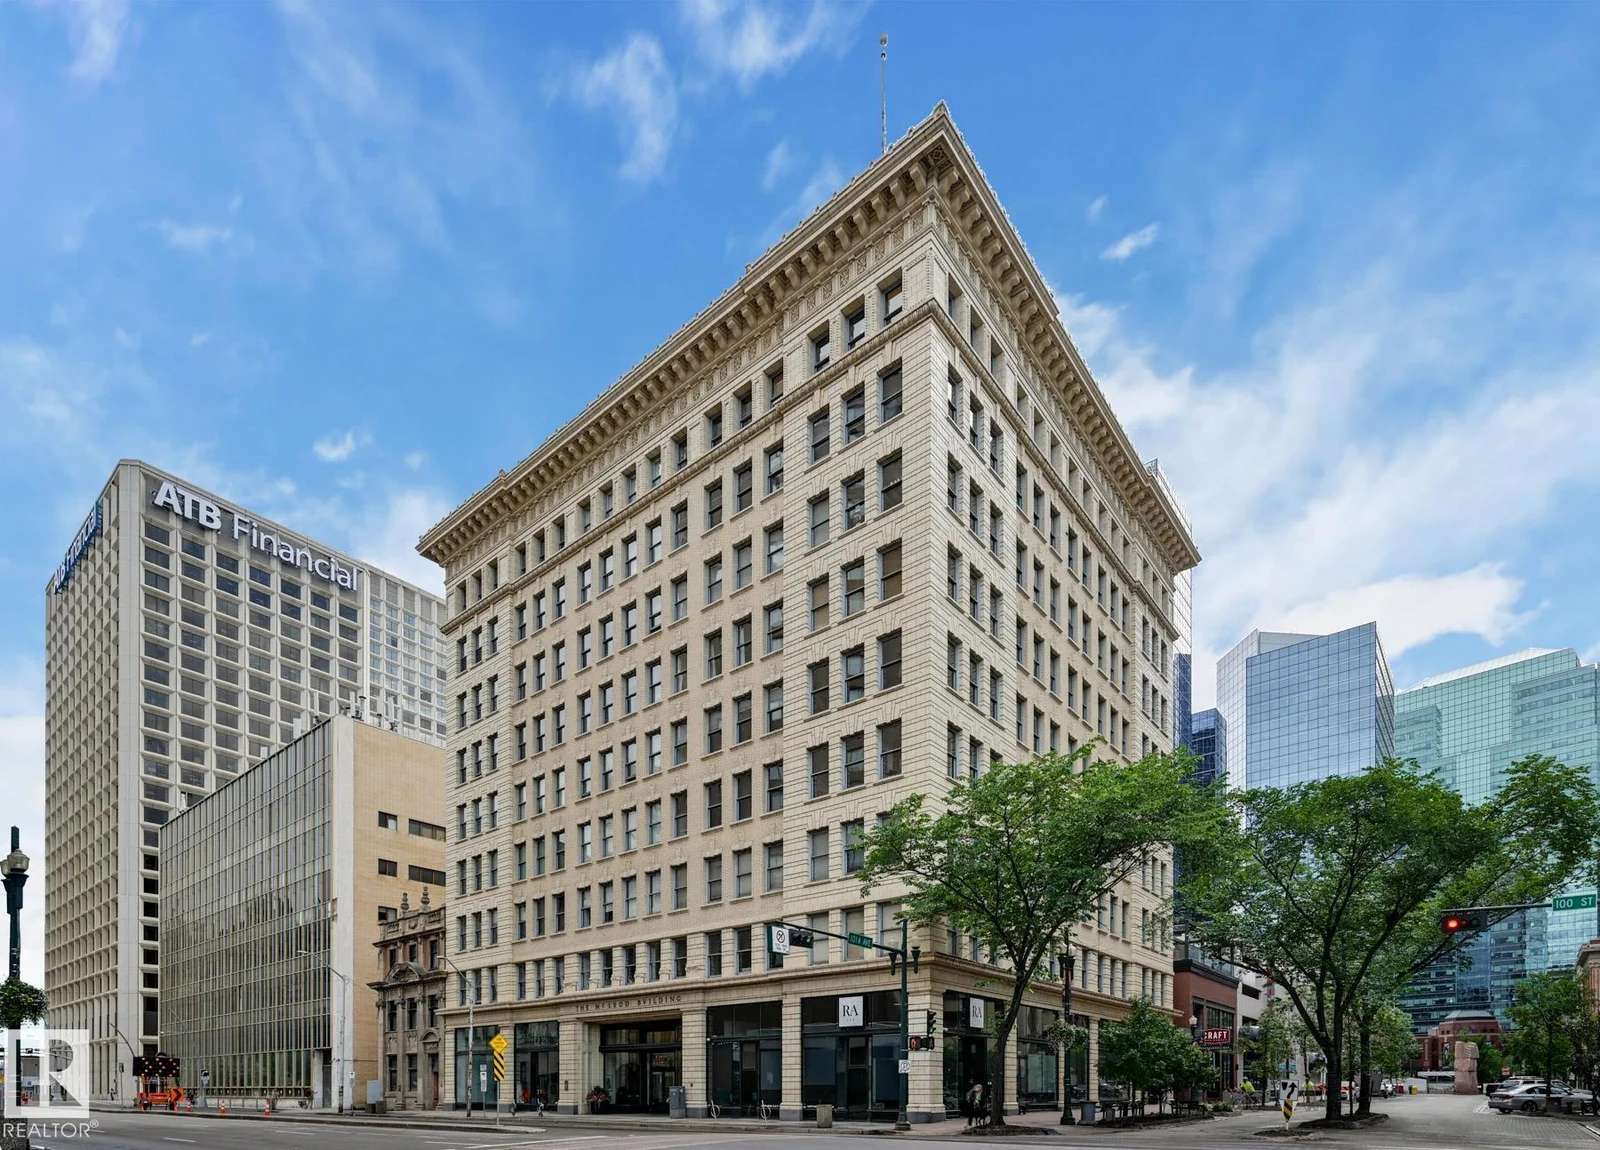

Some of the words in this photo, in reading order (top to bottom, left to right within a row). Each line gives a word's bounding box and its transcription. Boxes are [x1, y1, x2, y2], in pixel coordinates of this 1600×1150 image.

[154, 481, 222, 530] ATB
[232, 512, 358, 592] Financial
[1556, 898, 1573, 908] 100
[1581, 896, 1593, 906] ST
[576, 1004, 589, 1012] THE
[842, 1004, 859, 1017] RA
[972, 1005, 983, 1018] RA
